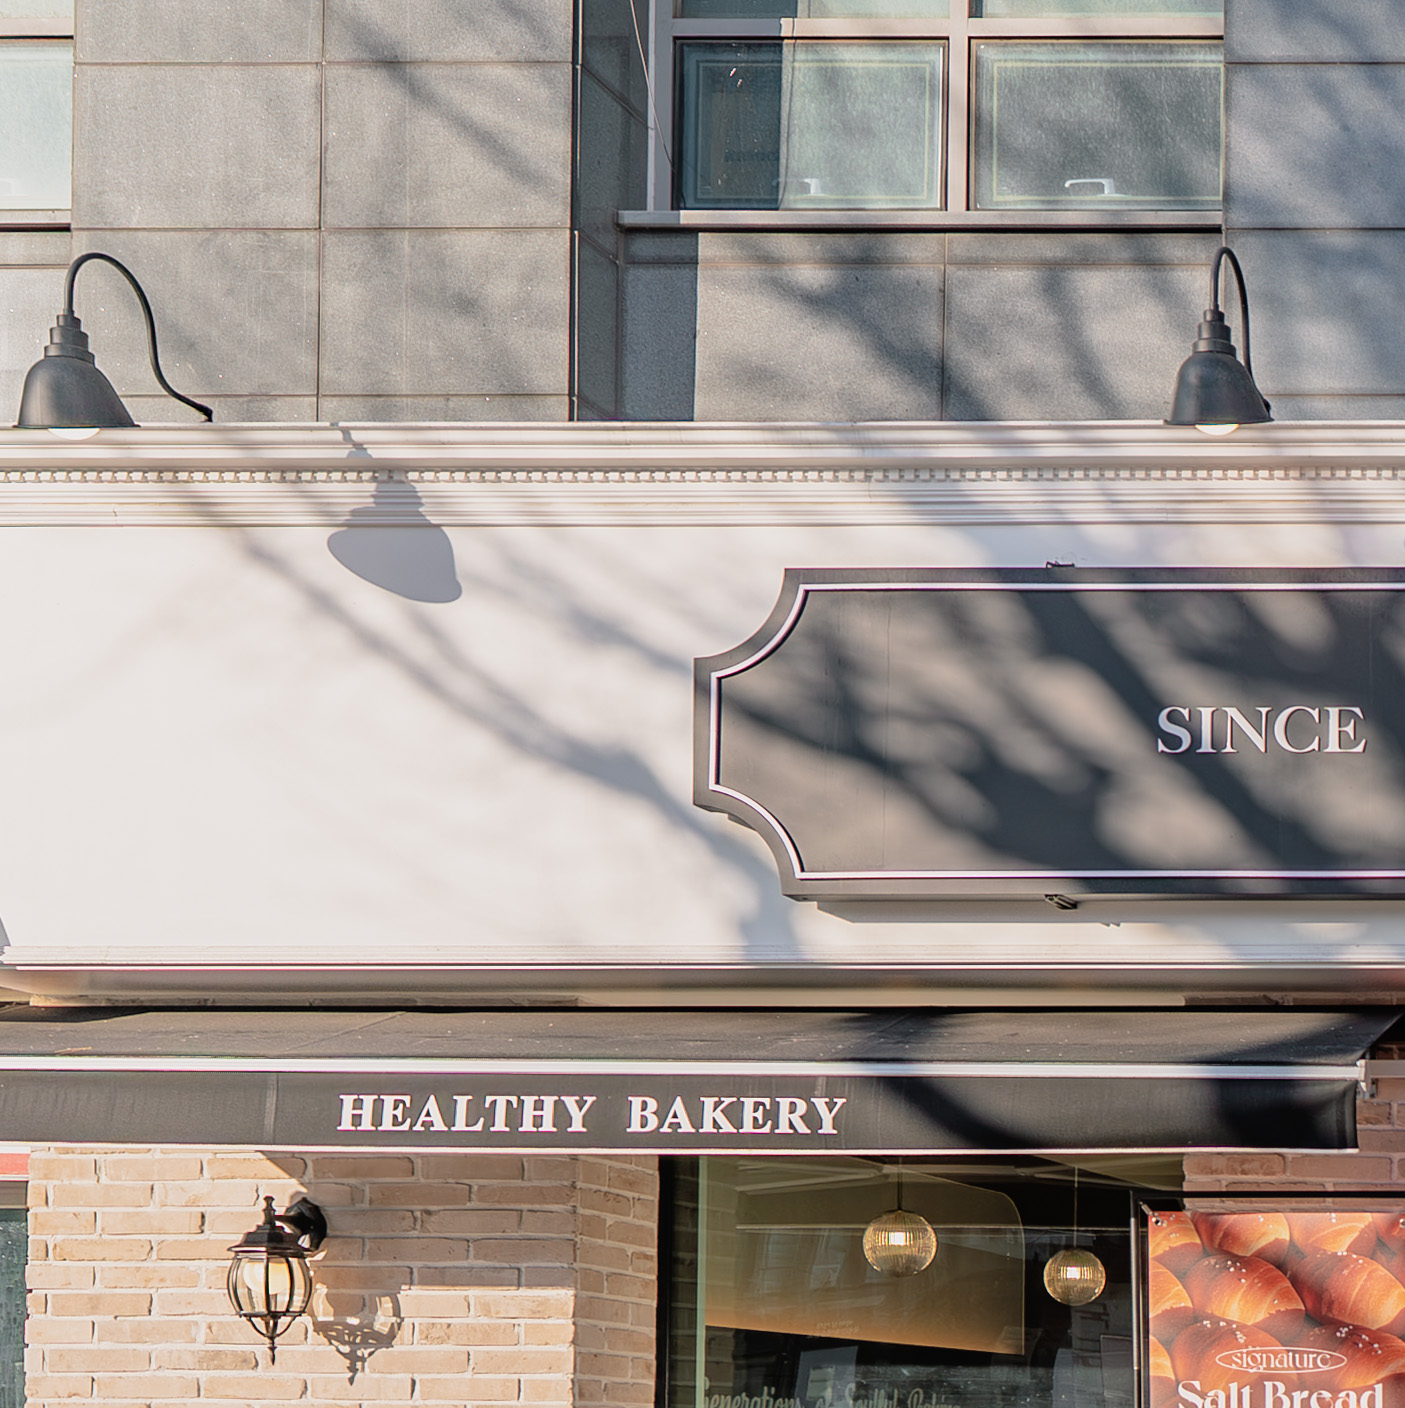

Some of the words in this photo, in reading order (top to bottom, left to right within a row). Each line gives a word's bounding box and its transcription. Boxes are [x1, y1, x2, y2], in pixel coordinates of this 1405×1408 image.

[1157, 704, 1368, 757] SINCE
[337, 1093, 597, 1133] HEALTHY
[626, 1095, 847, 1136] BAKERY
[1231, 1348, 1331, 1372] signature
